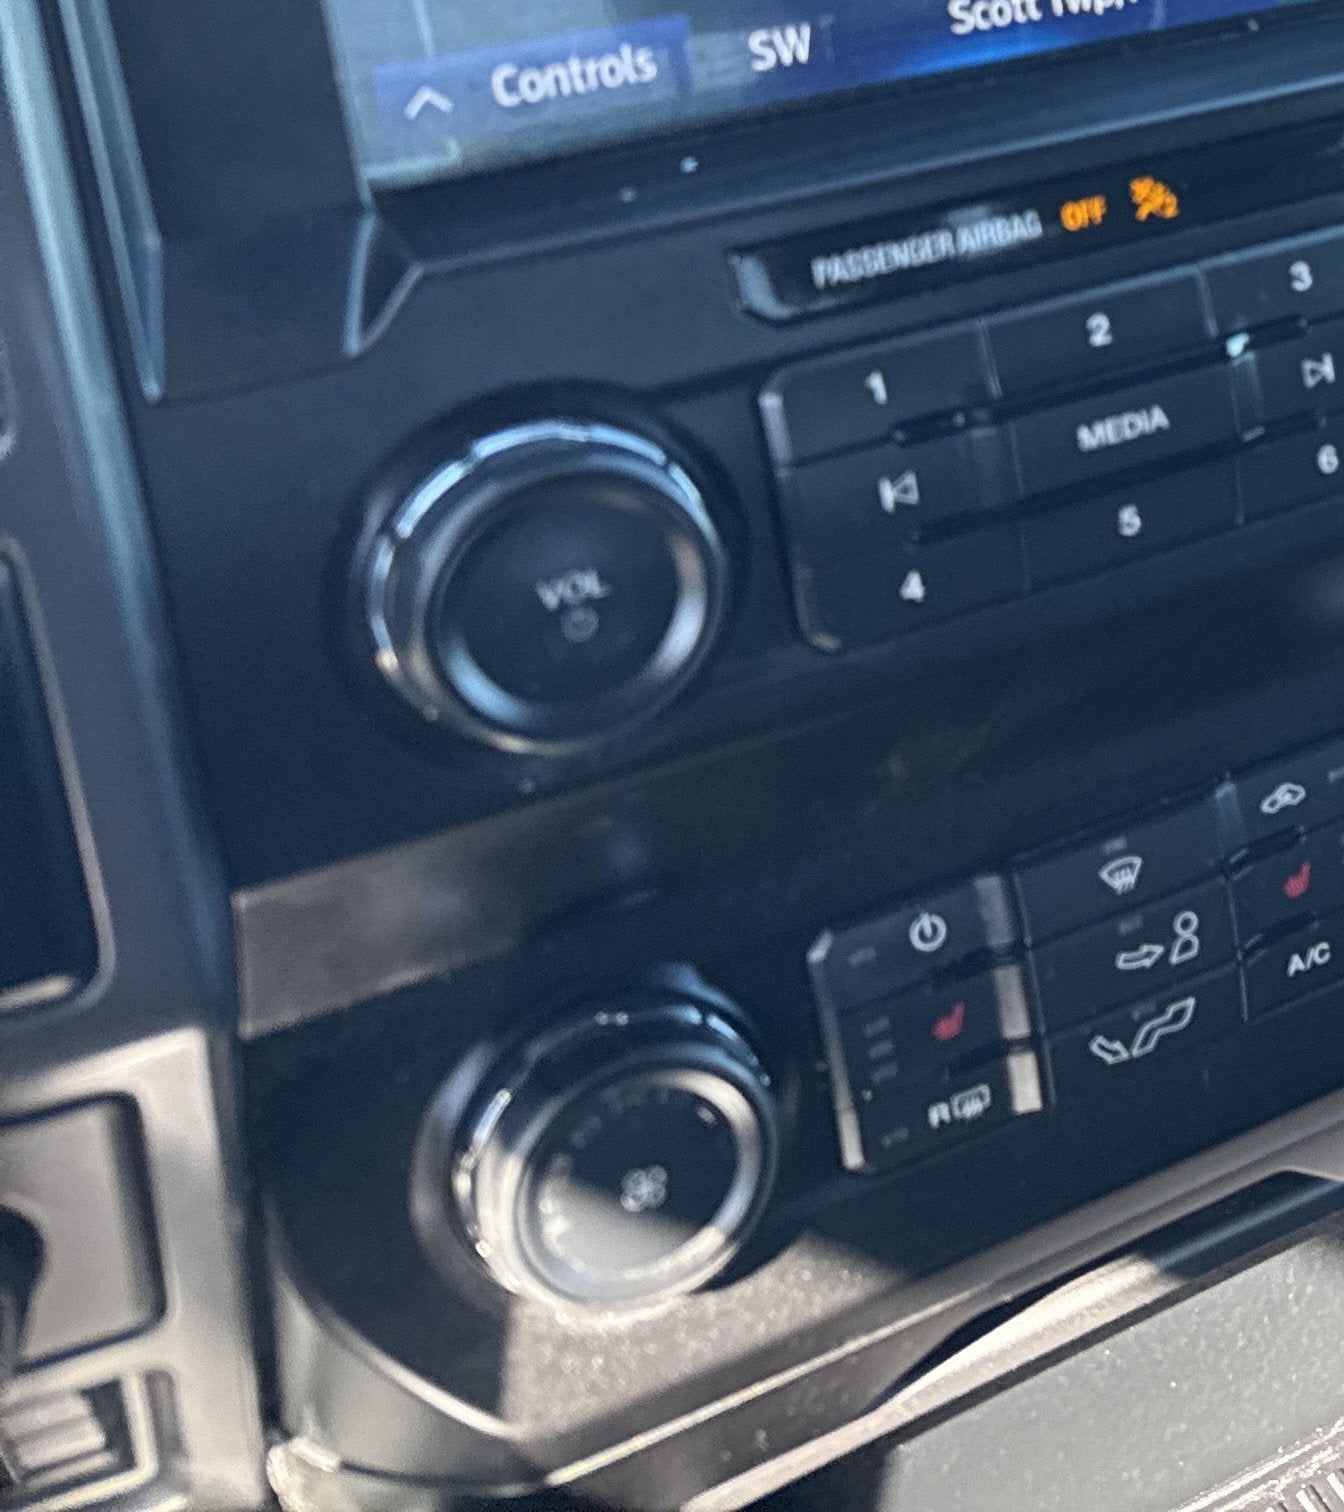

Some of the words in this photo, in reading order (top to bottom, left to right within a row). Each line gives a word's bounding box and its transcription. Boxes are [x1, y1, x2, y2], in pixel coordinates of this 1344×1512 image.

[491, 42, 658, 108] Controls
[747, 23, 812, 72] SW
[1059, 193, 1107, 232] OFF
[810, 228, 956, 288] PASSENGER
[955, 208, 1044, 260] AIRBAG
[1290, 260, 1314, 292] 3
[1085, 312, 1113, 348] 2
[865, 370, 889, 405] 1
[1075, 403, 1170, 453] MEDIA
[1316, 443, 1340, 475] 6
[1117, 503, 1143, 537] 5
[536, 568, 610, 610] VOL
[899, 569, 926, 603] 4
[1286, 941, 1332, 978] A/C
[928, 1101, 952, 1128] R
